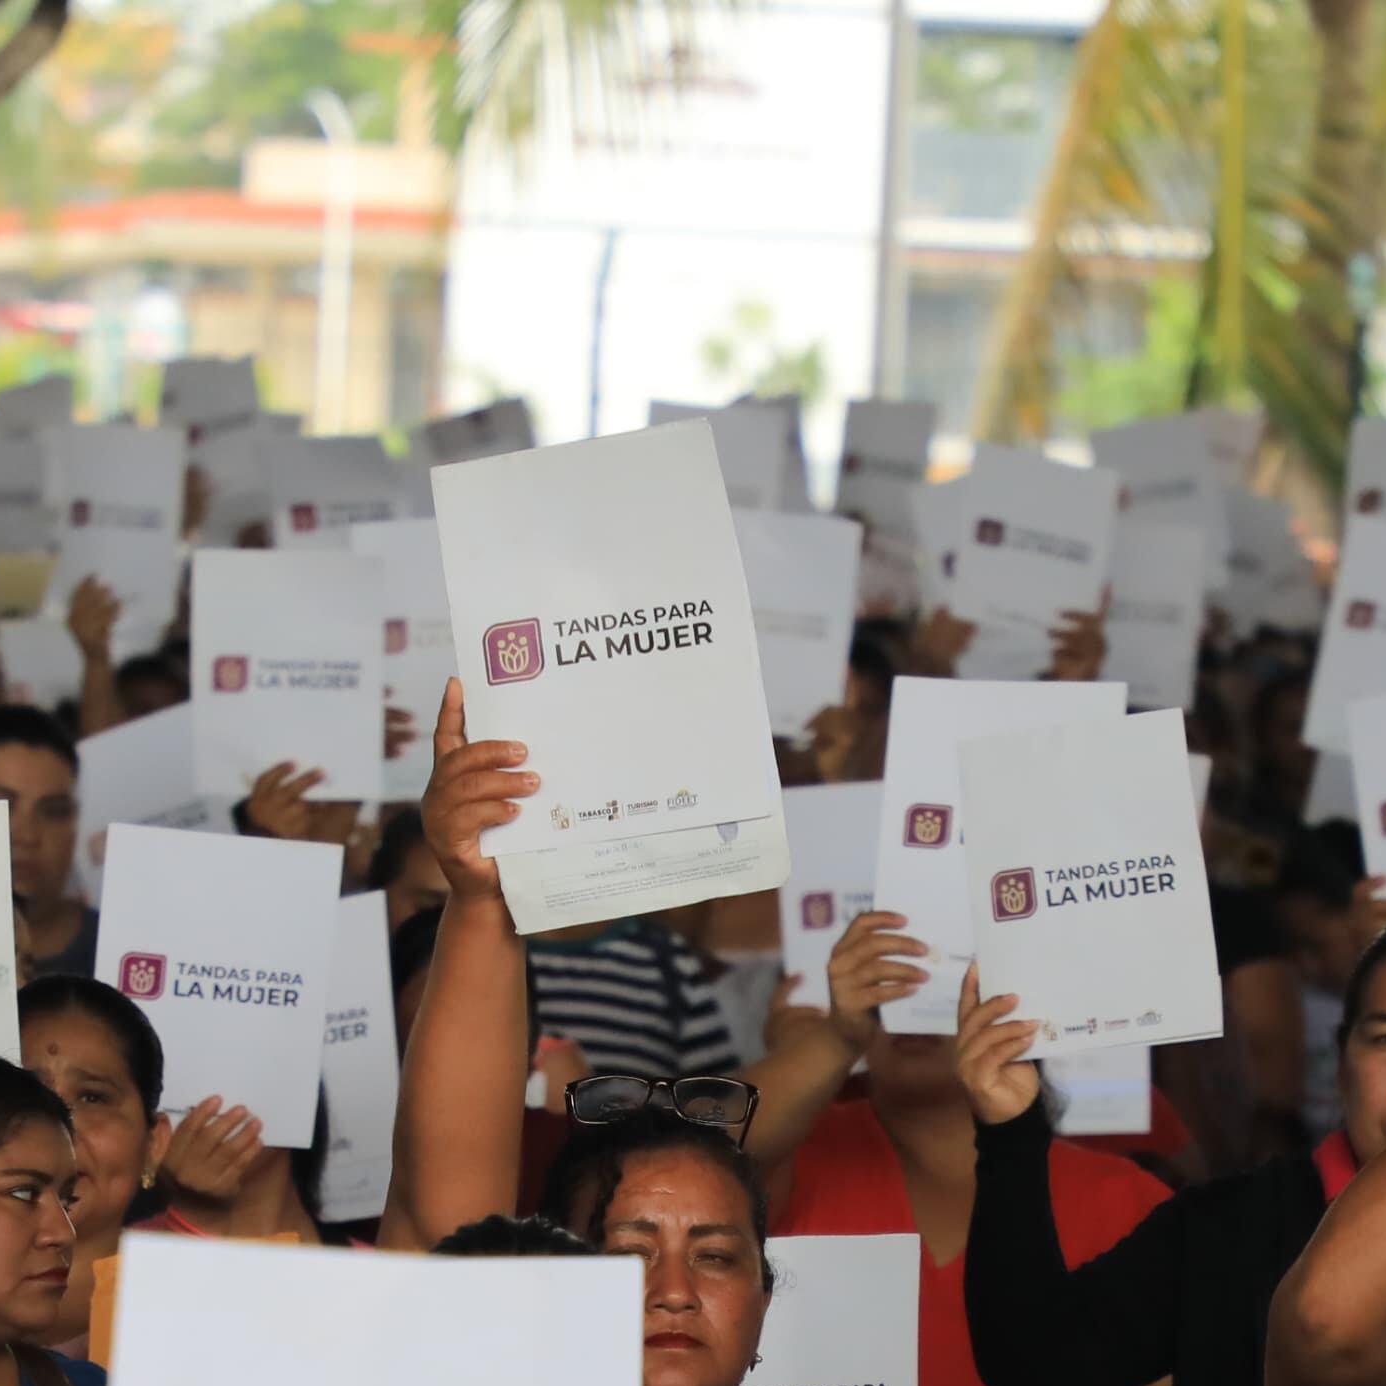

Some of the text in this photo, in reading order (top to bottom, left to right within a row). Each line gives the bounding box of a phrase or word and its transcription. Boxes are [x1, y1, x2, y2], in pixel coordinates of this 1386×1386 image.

[553, 600, 714, 638] TANDAS PARA
[555, 622, 714, 666] LA MUJER
[1044, 854, 1177, 883] TANDAS PARA
[1045, 873, 1175, 907] LA MUJER
[177, 962, 303, 986] TANDAS PARA
[174, 979, 299, 1007] LA MUJER
[323, 1022, 369, 1045] JER
